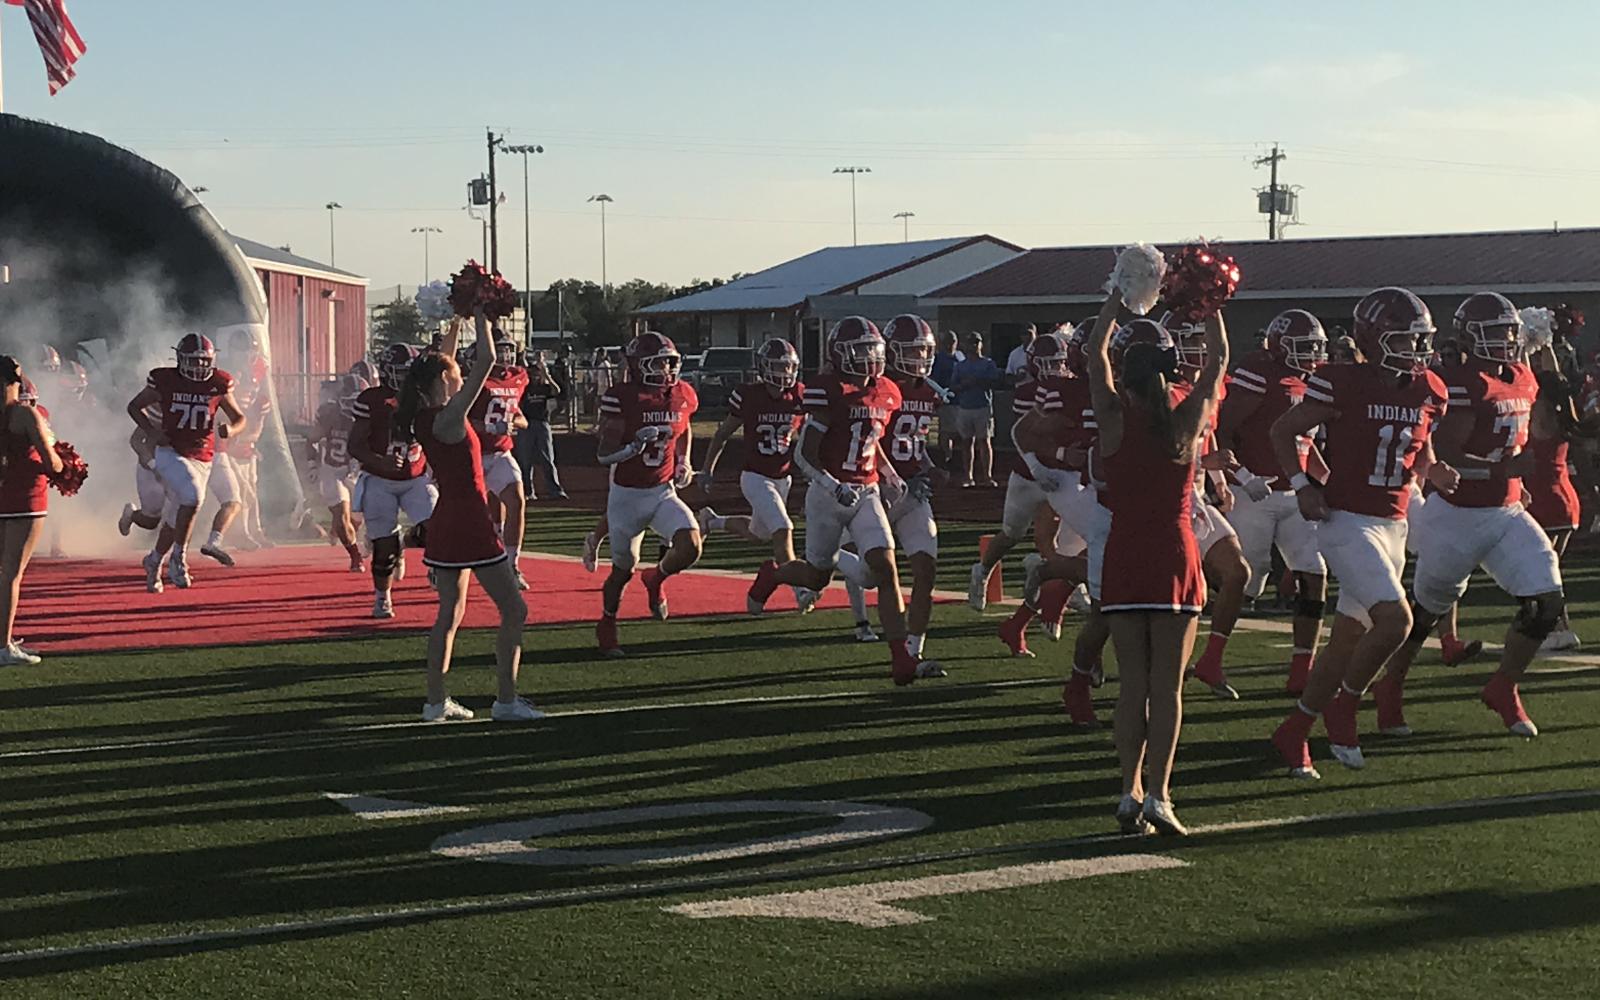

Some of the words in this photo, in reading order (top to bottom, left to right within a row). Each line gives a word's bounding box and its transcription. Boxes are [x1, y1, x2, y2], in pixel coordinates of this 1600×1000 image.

[169, 402, 212, 430] 70
[642, 411, 683, 423] INDIANS
[1367, 404, 1425, 424] INDIANS
[642, 425, 674, 467] 3
[1368, 424, 1414, 488] 11
